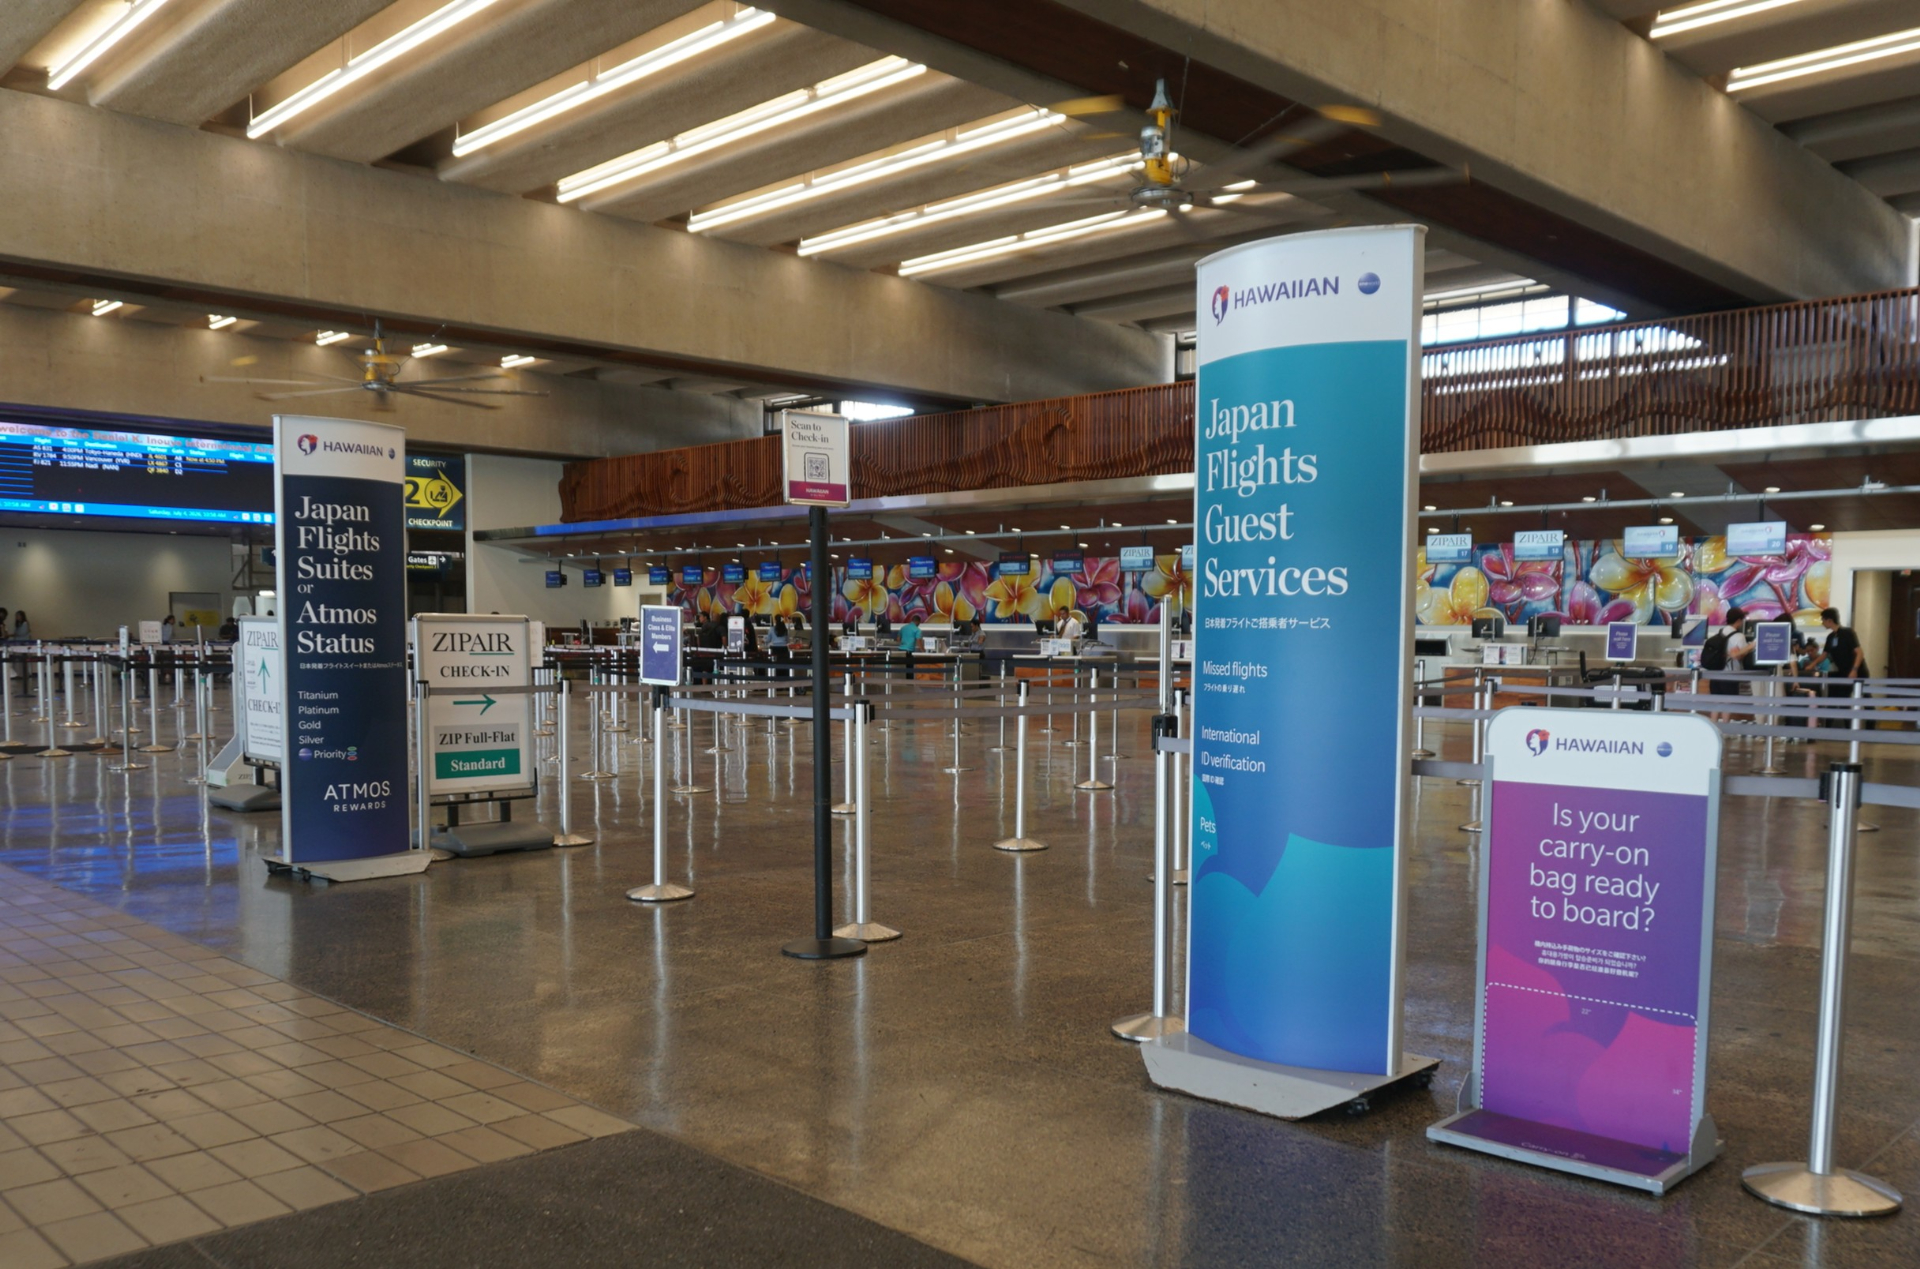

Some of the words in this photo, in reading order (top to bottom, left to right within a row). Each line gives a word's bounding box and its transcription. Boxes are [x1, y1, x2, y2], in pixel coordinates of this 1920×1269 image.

[1234, 276, 1340, 310] HAWAIIAN
[790, 420, 811, 431] Scan
[813, 422, 822, 432] to
[1205, 398, 1298, 444] Japan
[71, 429, 89, 438] the
[147, 436, 182, 447] Inouye
[186, 439, 251, 452] International
[791, 431, 829, 443] Check-in
[323, 441, 383, 456] HAWAIIAN
[413, 458, 446, 468] SECURITY
[1206, 444, 1318, 498] Flights
[405, 480, 420, 504] 2
[294, 496, 370, 525] Japan
[408, 518, 453, 527] CHECKPOINT
[1205, 503, 1294, 545] Guest
[297, 526, 380, 555] Flights
[1430, 537, 1467, 546] ZIPAIR
[1519, 533, 1558, 543] ZIPAIR
[1771, 540, 1781, 548] 20
[1123, 549, 1150, 557] ZIPAIR
[1665, 543, 1673, 551] 19
[297, 556, 373, 579] Suites
[408, 556, 427, 564] Gates
[1204, 556, 1349, 598] Services
[297, 584, 314, 594] or
[296, 600, 377, 624] Atmos
[665, 624, 676, 632] Elite
[247, 631, 278, 647] ZIPAIR
[297, 630, 374, 654] Status
[432, 633, 514, 652] ZIPAIR
[440, 666, 510, 678] CHECK-IN
[1203, 660, 1230, 676] Missed
[1232, 661, 1268, 680] flights
[297, 691, 338, 700] Titanium
[298, 706, 339, 714] Platinum
[298, 721, 321, 729] Gold
[298, 736, 324, 744] Silver
[439, 733, 463, 745] ZIP
[465, 731, 515, 744] Full-Flat
[1201, 725, 1260, 745] International
[1556, 738, 1644, 755] HAWAIIAN
[314, 750, 347, 760] Priority
[1201, 751, 1210, 766] ID
[1211, 755, 1266, 773] verification
[451, 757, 505, 772] Standard
[324, 781, 388, 800] ATMOS
[333, 801, 386, 812] REWARDS
[1200, 817, 1216, 834] Pets
[1554, 802, 1572, 827] Is
[1578, 810, 1640, 834] your
[1539, 838, 1649, 867] carry-on
[1530, 862, 1577, 896] bag
[1585, 874, 1660, 905] ready
[1531, 896, 1556, 919] to
[1563, 898, 1655, 932] board?
